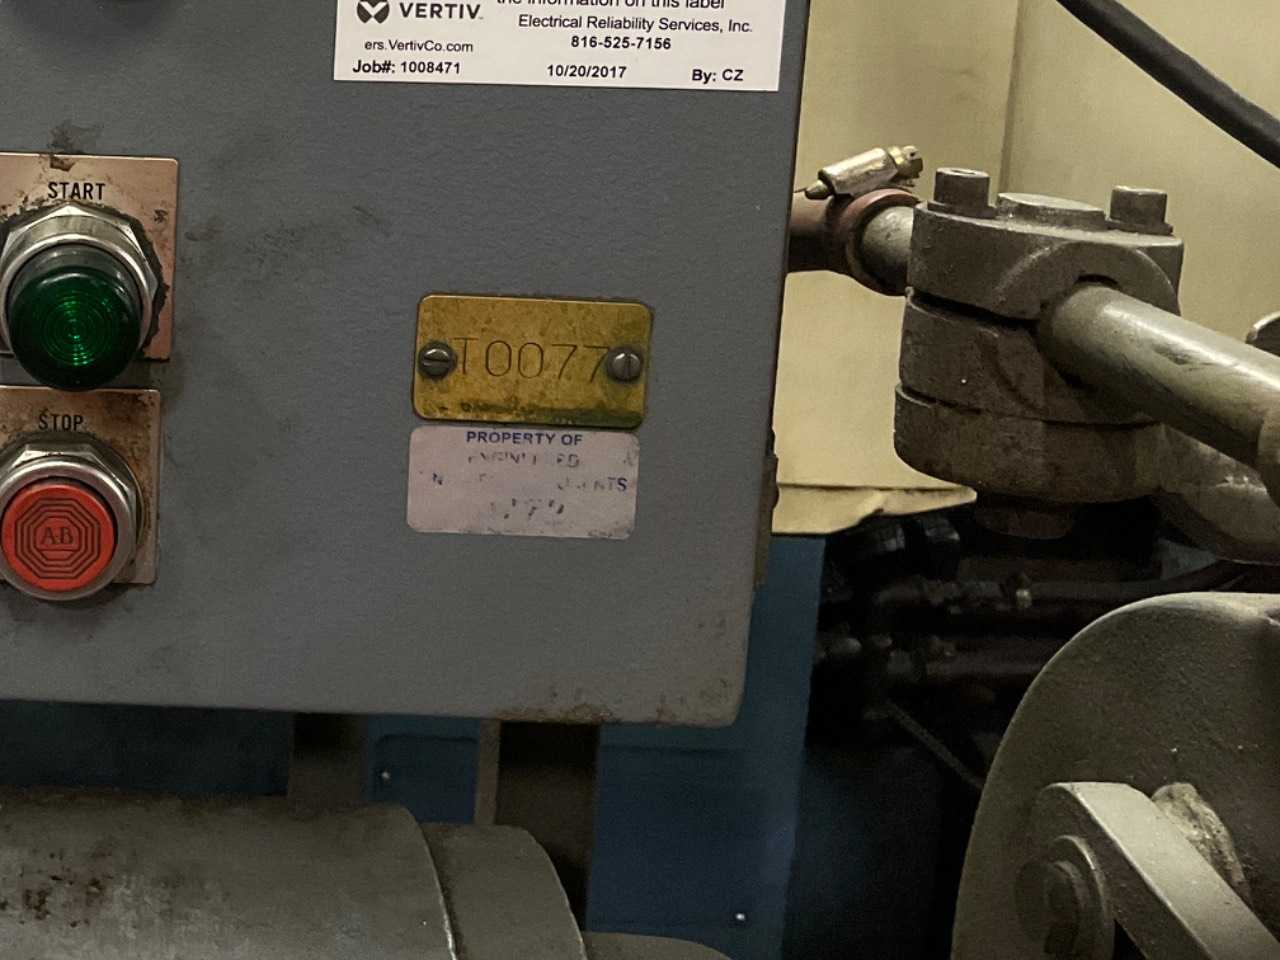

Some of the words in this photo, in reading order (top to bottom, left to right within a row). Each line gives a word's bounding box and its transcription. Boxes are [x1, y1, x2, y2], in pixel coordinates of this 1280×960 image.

[399, 2, 481, 19] VERTIV
[519, 15, 582, 28] Electrical
[587, 16, 654, 32] Reliability
[659, 18, 723, 33] Services,
[728, 19, 752, 33] Inc.
[365, 39, 473, 52] ers.VertivCo.com
[571, 36, 671, 50] 816-525-7156
[353, 60, 395, 74] Job#:
[401, 61, 460, 74] 1008471
[547, 65, 626, 78] 10/20/2017
[692, 69, 716, 84] By:
[722, 69, 744, 81] CZ
[48, 181, 105, 200] START
[453, 337, 609, 383] T0077
[38, 414, 84, 431] STOP
[467, 431, 556, 445] PROPERTY
[561, 434, 582, 445] OF
